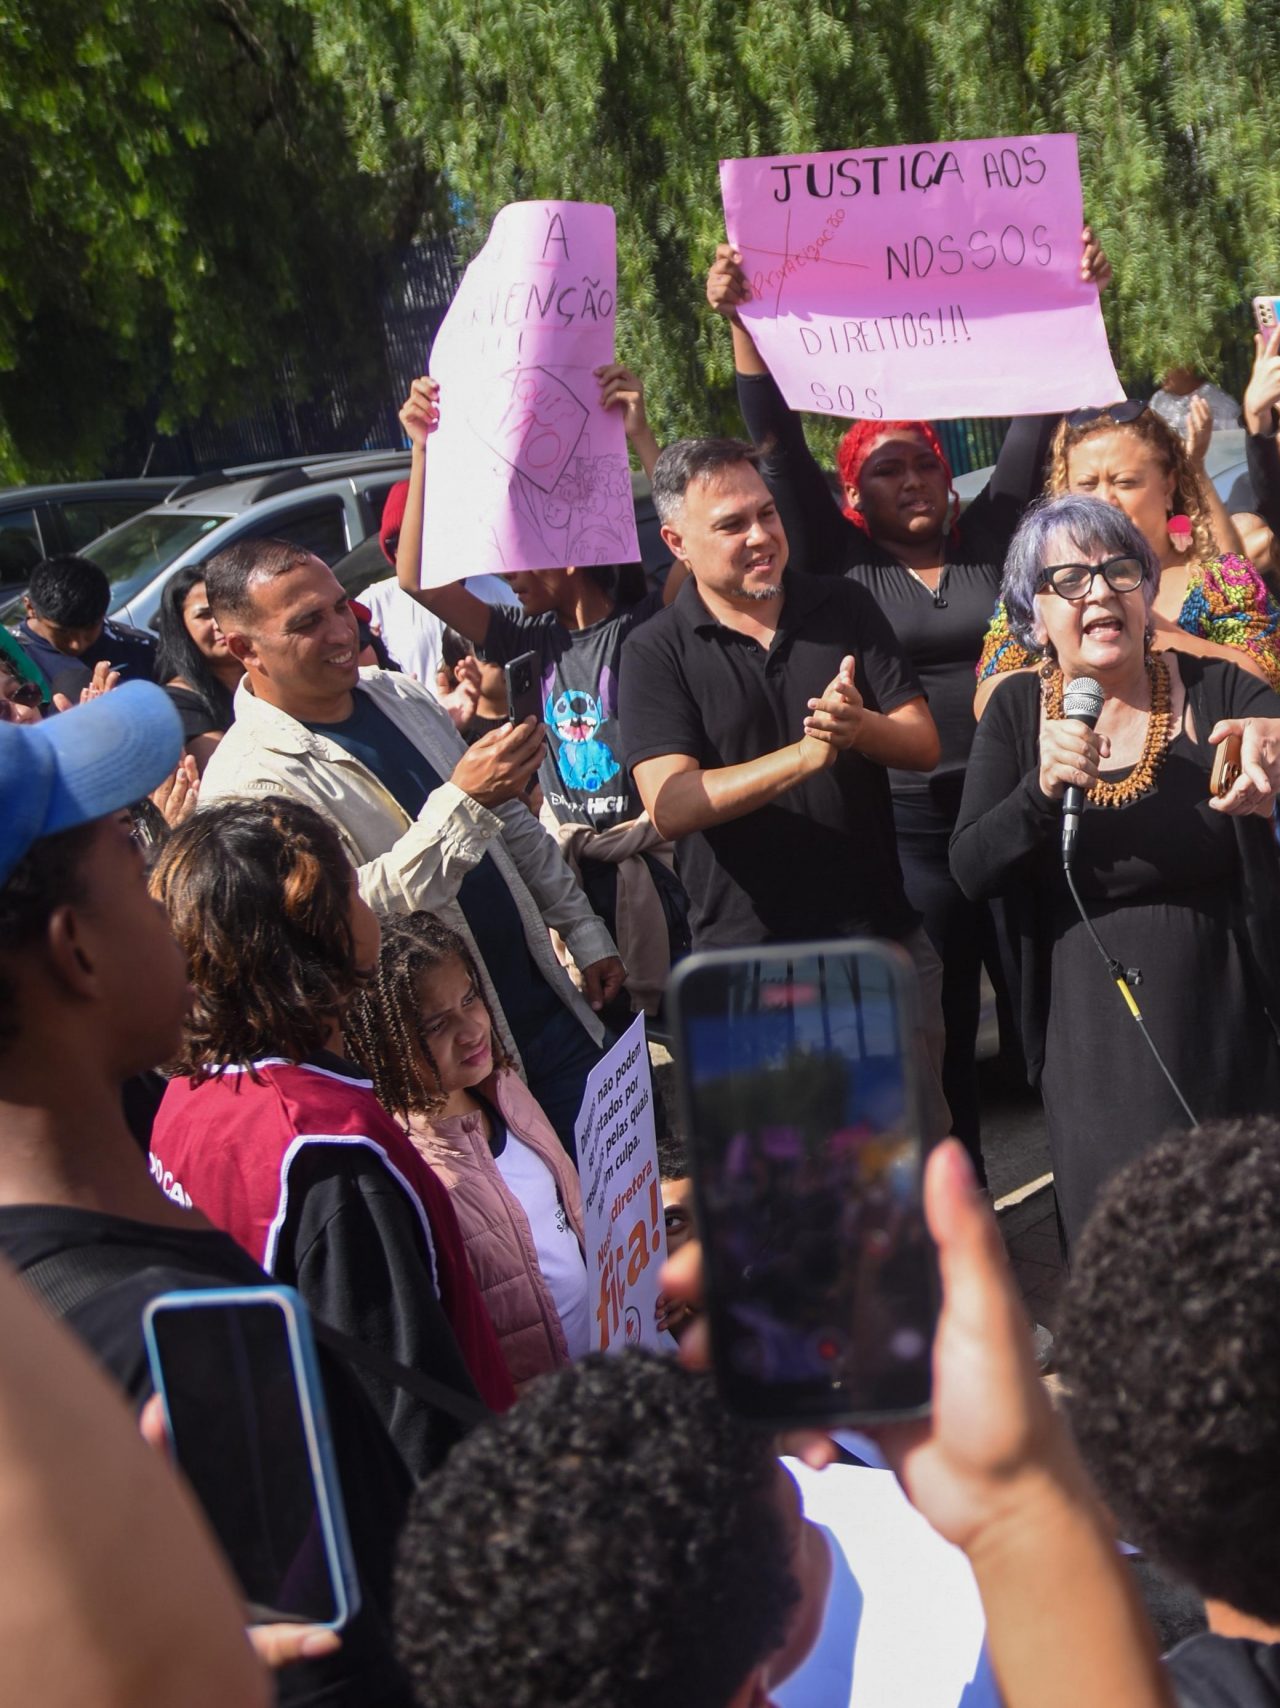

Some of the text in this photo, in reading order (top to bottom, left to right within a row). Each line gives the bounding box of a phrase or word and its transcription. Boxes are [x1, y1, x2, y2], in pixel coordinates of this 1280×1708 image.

[770, 146, 1046, 202] JUSTIÇA AOS
[886, 224, 1052, 280] NOSSOS
[799, 304, 972, 356] DIREITOS!!!
[597, 1075, 614, 1104] não
[615, 1040, 642, 1088] podem
[625, 1074, 639, 1108] por
[606, 1118, 629, 1158] pelas
[630, 1088, 649, 1127] quais
[615, 1137, 641, 1171] culpa.
[610, 1159, 653, 1223] diretora
